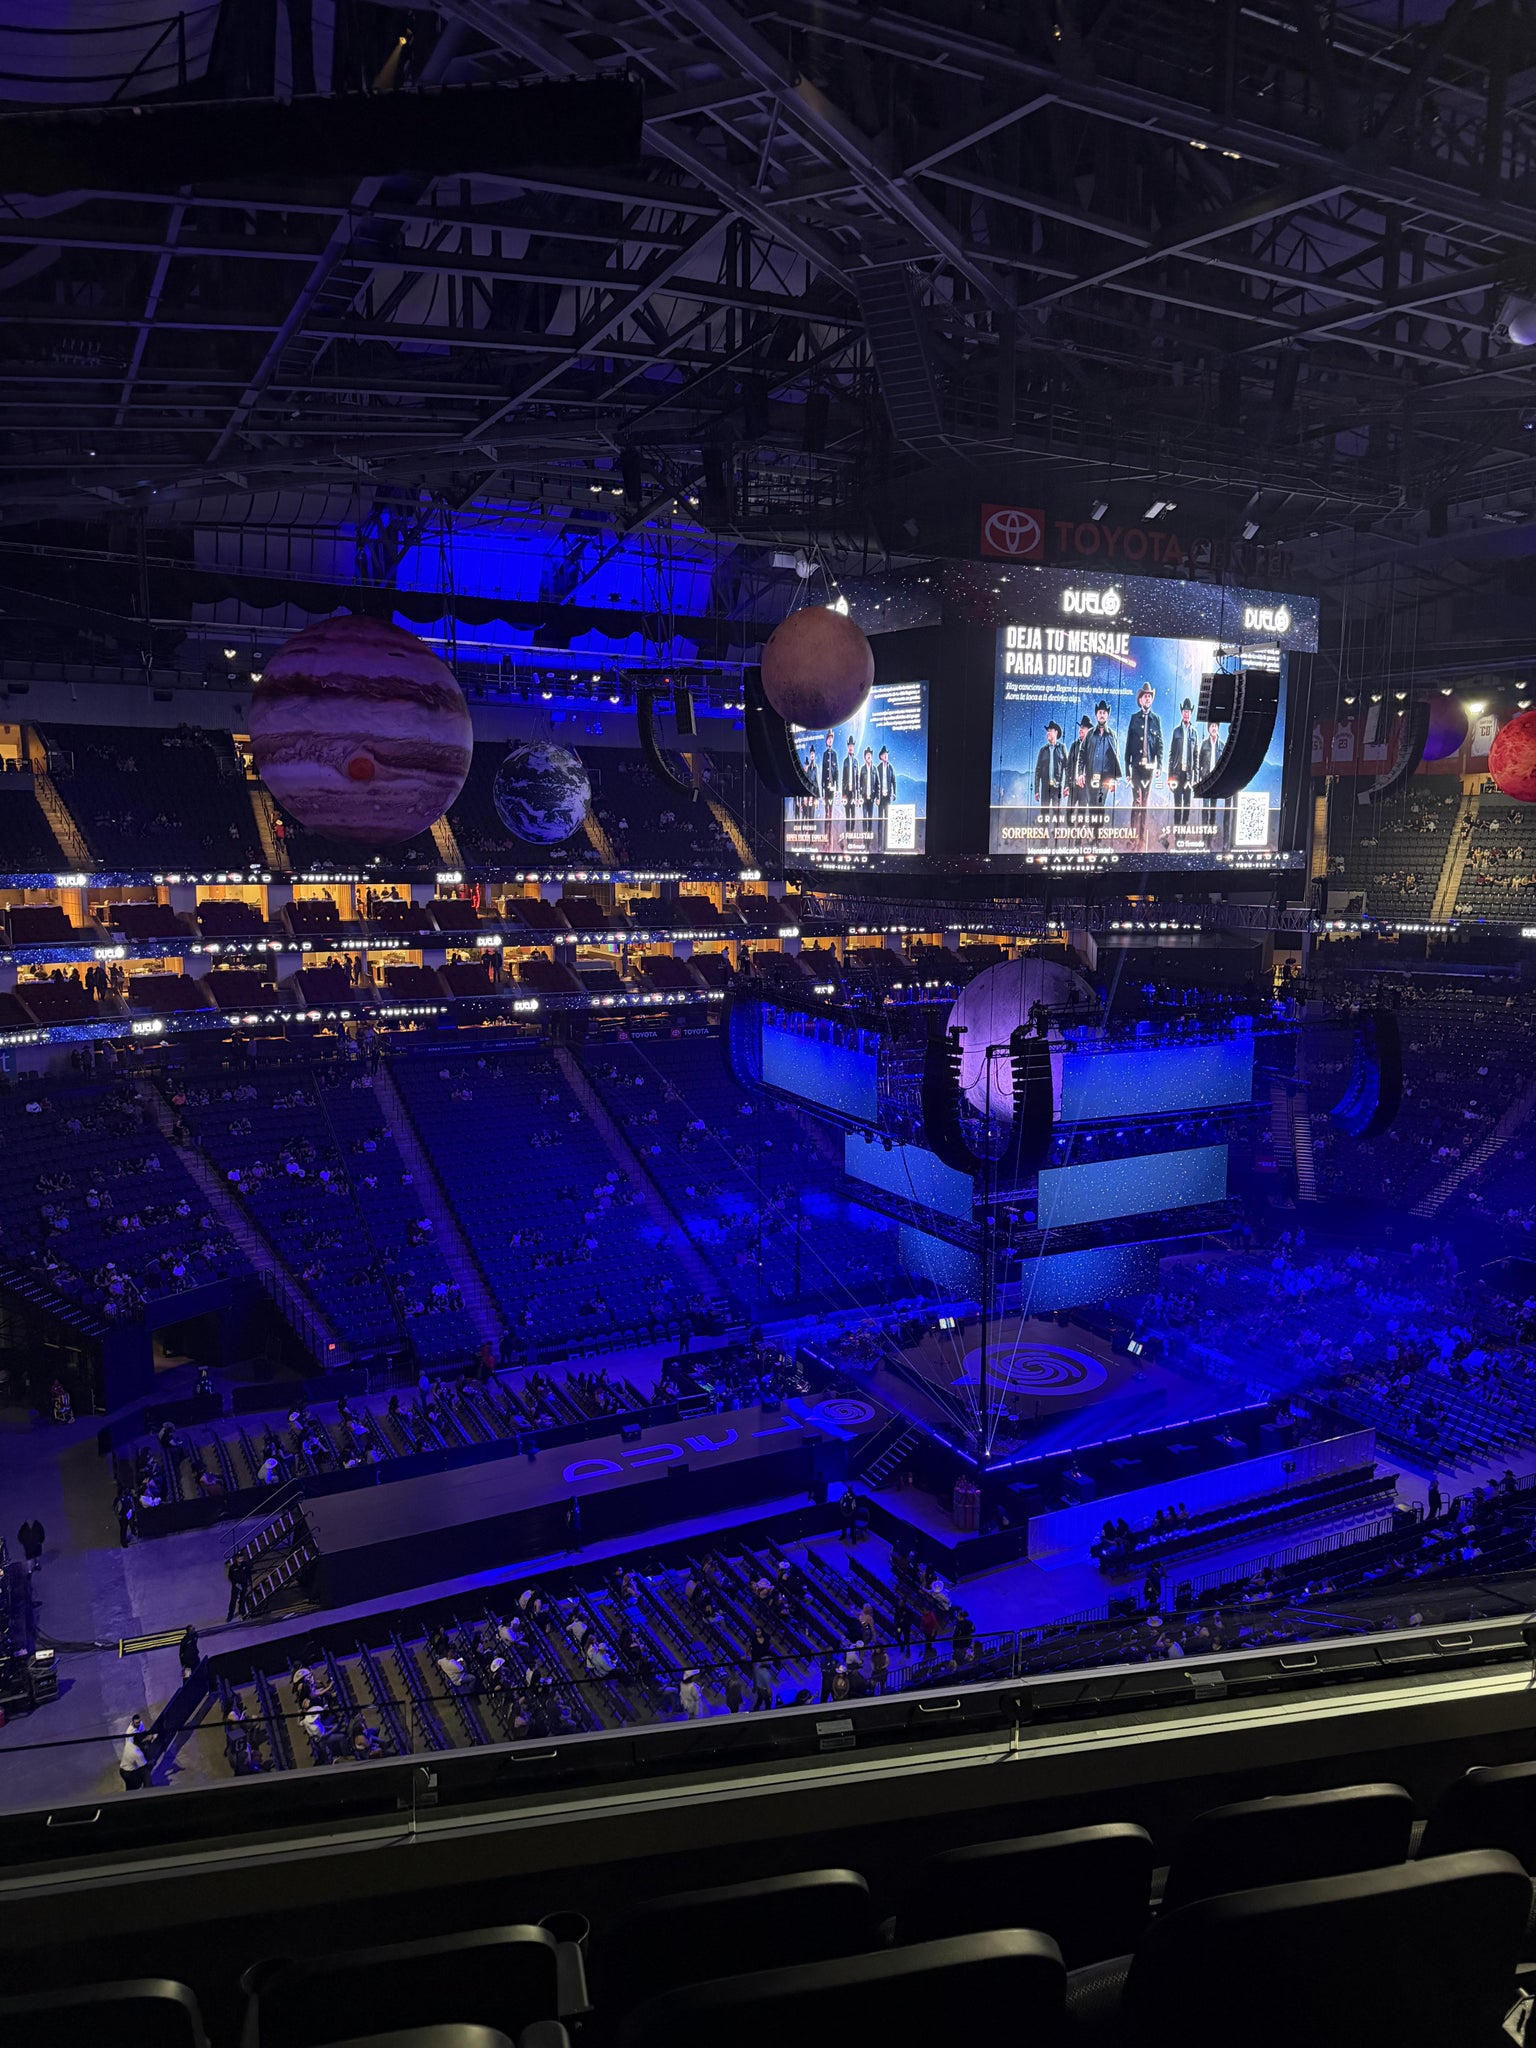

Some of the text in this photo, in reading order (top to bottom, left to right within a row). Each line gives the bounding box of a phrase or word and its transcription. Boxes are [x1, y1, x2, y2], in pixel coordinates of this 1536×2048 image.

[1054, 521, 1183, 564] TOYOTA
[1063, 587, 1122, 615] DUELO
[1245, 606, 1291, 632] DUELO
[1007, 626, 1130, 655] DEJA TU MENSAJE
[1006, 653, 1092, 677] PARA DUELO
[1091, 779, 1194, 789] GRAVEDA
[1037, 815, 1110, 823] GRAN PREMIO
[1002, 825, 1138, 839] SORPRESA EDICIÓN ESPECIAL
[1173, 826, 1217, 834] FINALISTAS
[810, 854, 868, 862] GRAVEDAD
[1216, 853, 1289, 861] GRAVEDAD
[56, 873, 86, 886] DUELO
[153, 873, 272, 884] GRAVEDAD
[516, 873, 611, 882] GRAVEDAD
[555, 933, 650, 943] GRAVEDAD
[94, 945, 125, 960] DUELO
[191, 942, 312, 952] GRAVEDAD
[591, 993, 686, 1005] GRAVEDAD
[230, 1010, 351, 1024] GRAVEDAD
[133, 1019, 163, 1034] DUELO
[683, 1028, 709, 1036] TOYOTA
[631, 1031, 657, 1039] TOYOTA
